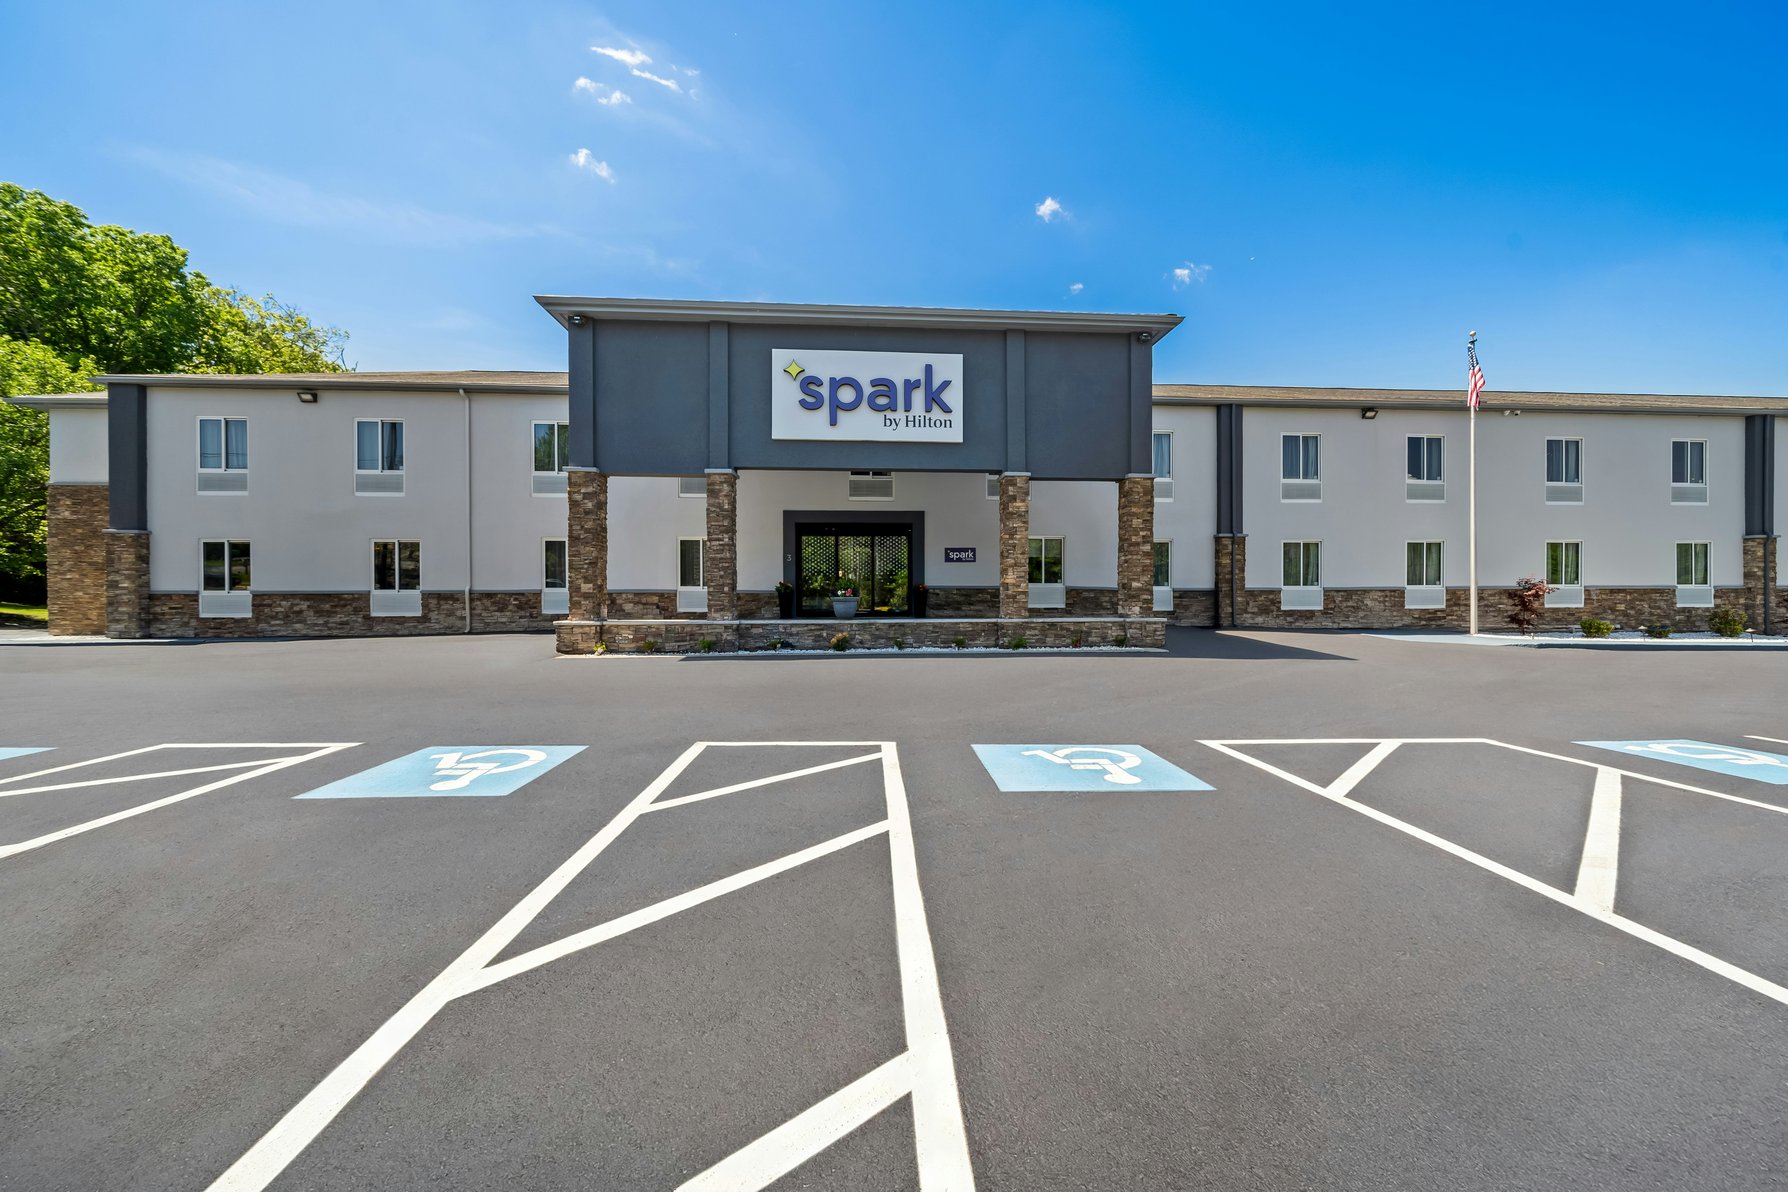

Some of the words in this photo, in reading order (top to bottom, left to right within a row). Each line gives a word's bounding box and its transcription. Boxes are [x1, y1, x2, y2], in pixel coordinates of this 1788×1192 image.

[798, 364, 953, 426] spark
[883, 415, 901, 431] by
[904, 415, 953, 429] Hilton
[949, 549, 974, 561] spark
